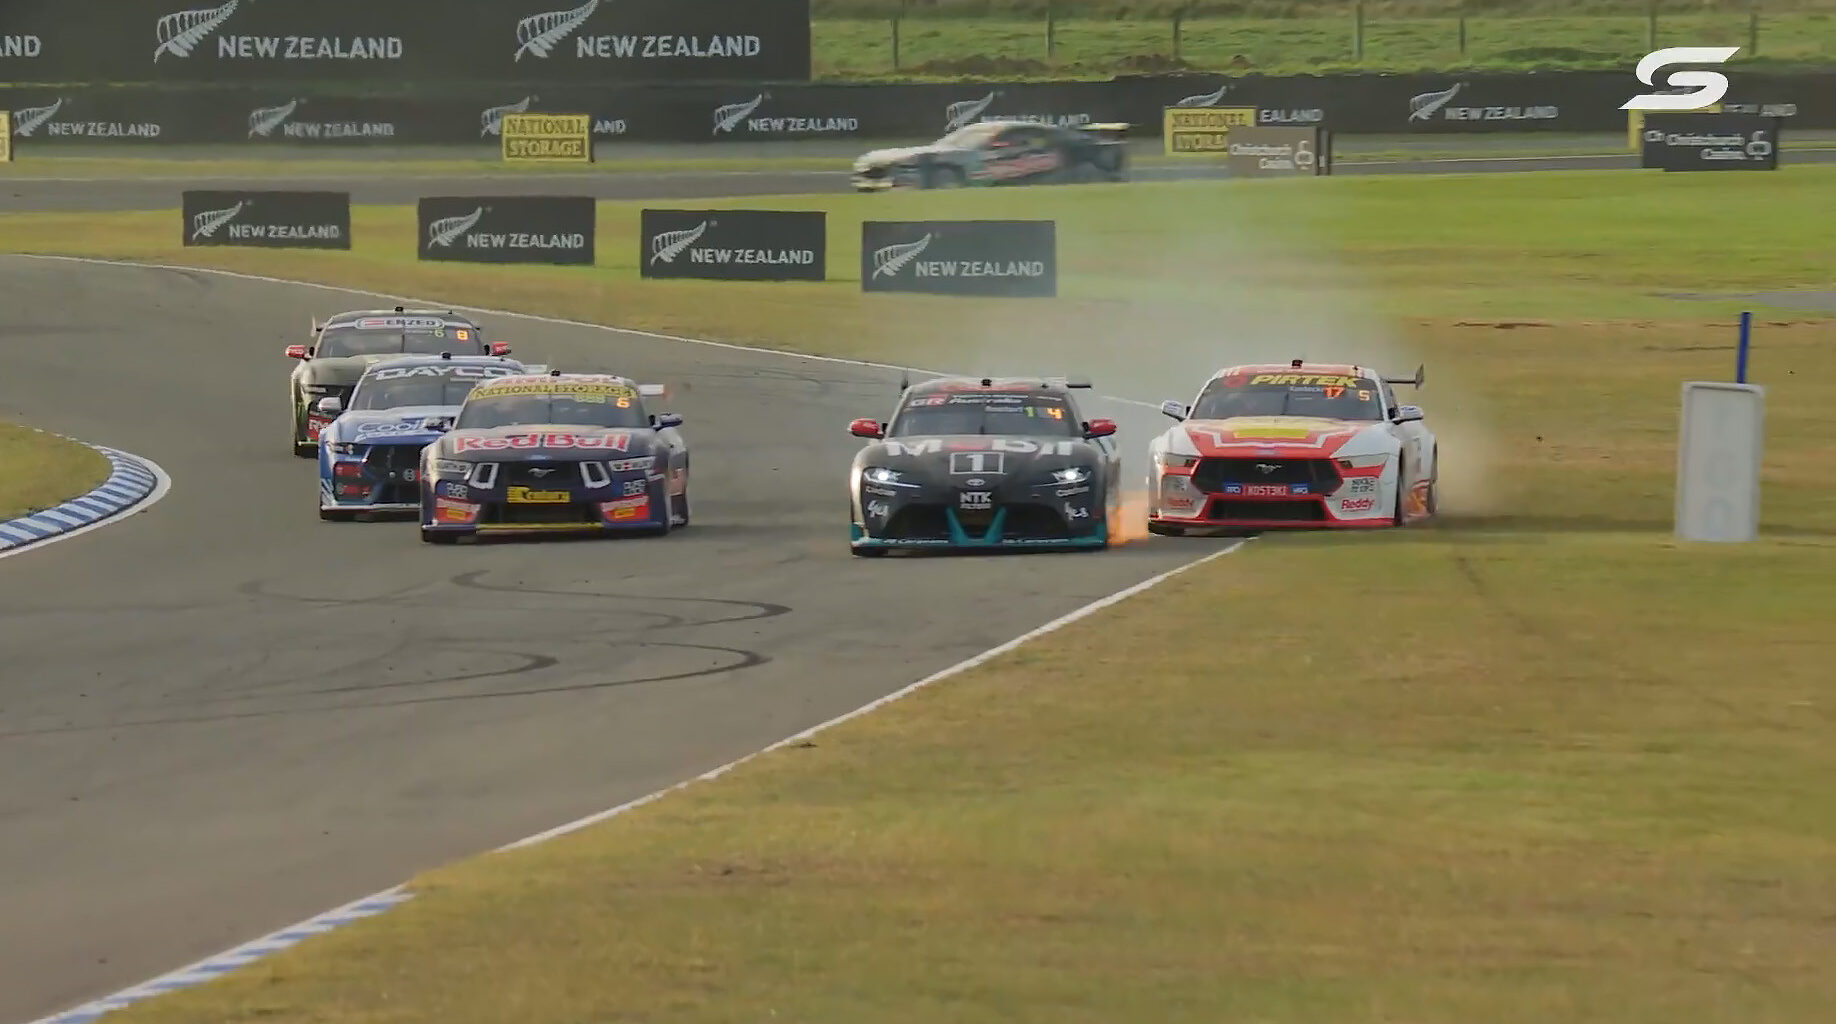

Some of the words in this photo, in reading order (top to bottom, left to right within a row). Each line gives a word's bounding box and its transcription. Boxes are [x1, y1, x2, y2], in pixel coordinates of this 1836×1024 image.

[0, 36, 41, 57] ND
[218, 35, 280, 58] NEW
[284, 36, 402, 58] ZEALAND
[577, 35, 637, 58] NEW
[641, 35, 760, 58] ZEALAND
[1260, 109, 1324, 122] EALAND
[49, 122, 86, 136] NEW
[88, 122, 160, 137] ZEALAND
[284, 122, 321, 137] NEW
[324, 122, 395, 137] ZEALAND
[506, 119, 584, 134] NATIONAL
[594, 119, 627, 134] AND
[749, 117, 784, 132] NEW
[788, 117, 858, 132] ZEALAND
[509, 140, 582, 156] STORAGE
[229, 224, 265, 238] NEW
[268, 224, 341, 239] ZEALAND
[467, 233, 506, 248] NEW
[509, 233, 584, 248] ZEALAND
[691, 248, 731, 264] NEW
[734, 249, 814, 265] ZEALAND
[916, 261, 957, 277] NEW
[960, 261, 1044, 277] ZEALAND
[385, 318, 435, 327] ENZED
[456, 328, 468, 341] 8
[376, 365, 522, 380] DAYCO
[1251, 374, 1357, 387] PIRTEK
[475, 385, 549, 398] NATIONAL
[1326, 386, 1345, 399] 17
[454, 433, 540, 453] Red
[546, 433, 631, 452] Bull
[966, 454, 984, 472] 1
[960, 491, 992, 503] NTK
